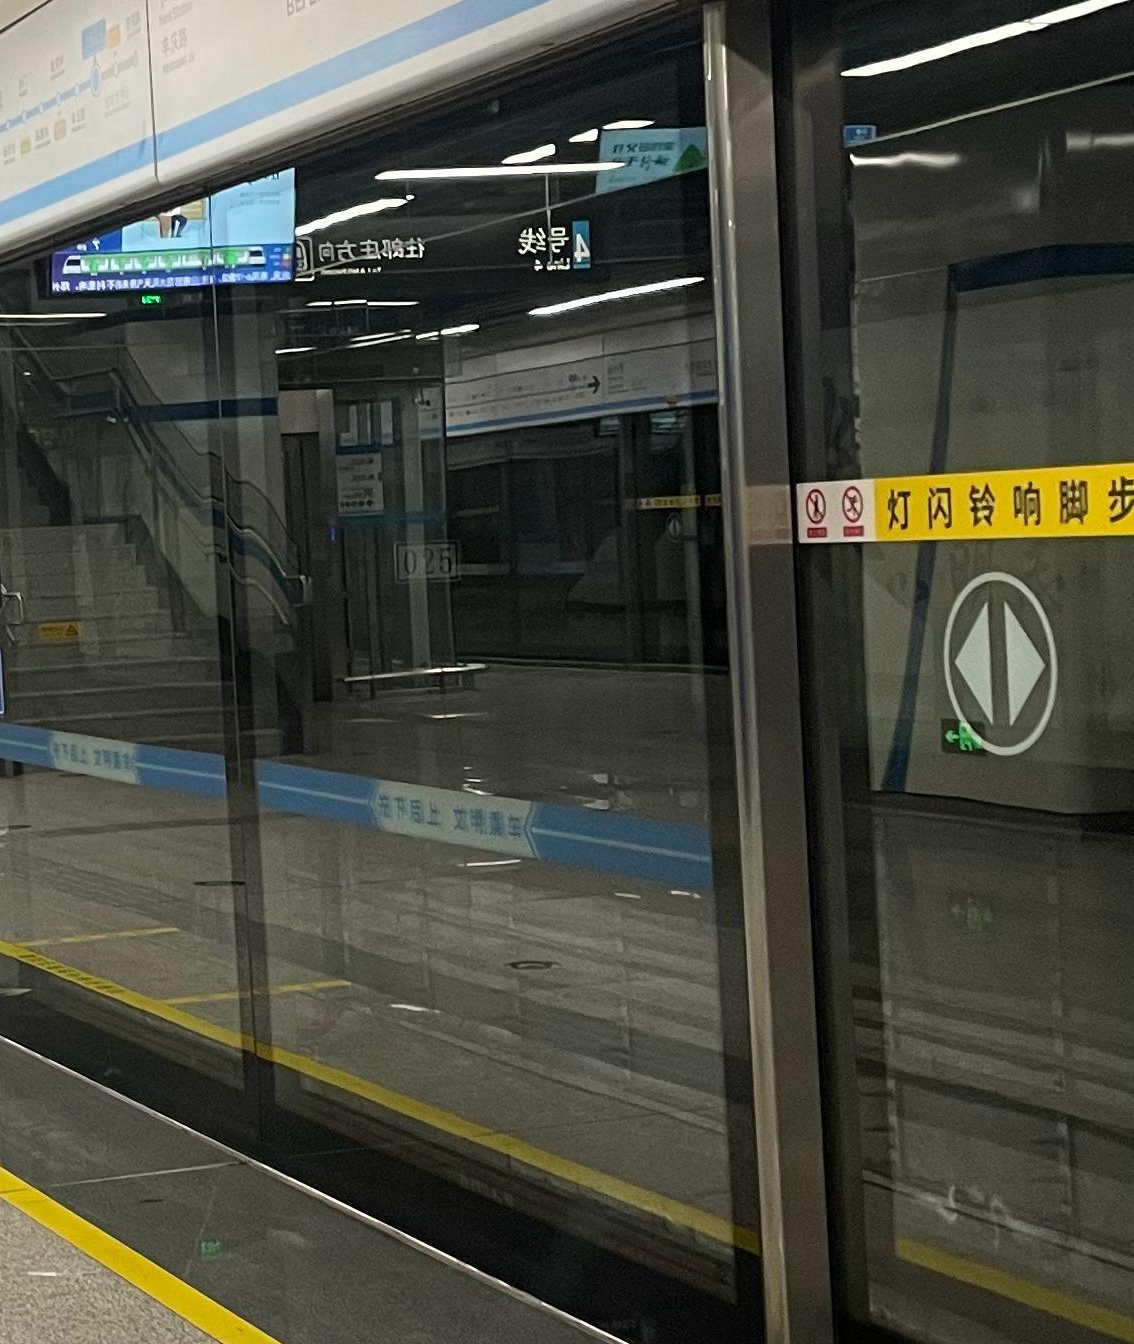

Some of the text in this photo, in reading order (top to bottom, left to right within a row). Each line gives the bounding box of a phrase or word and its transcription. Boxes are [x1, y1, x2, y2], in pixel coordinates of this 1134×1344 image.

[888, 475, 1134, 530] 灯闪铃响脚步
[404, 547, 452, 575] 025
